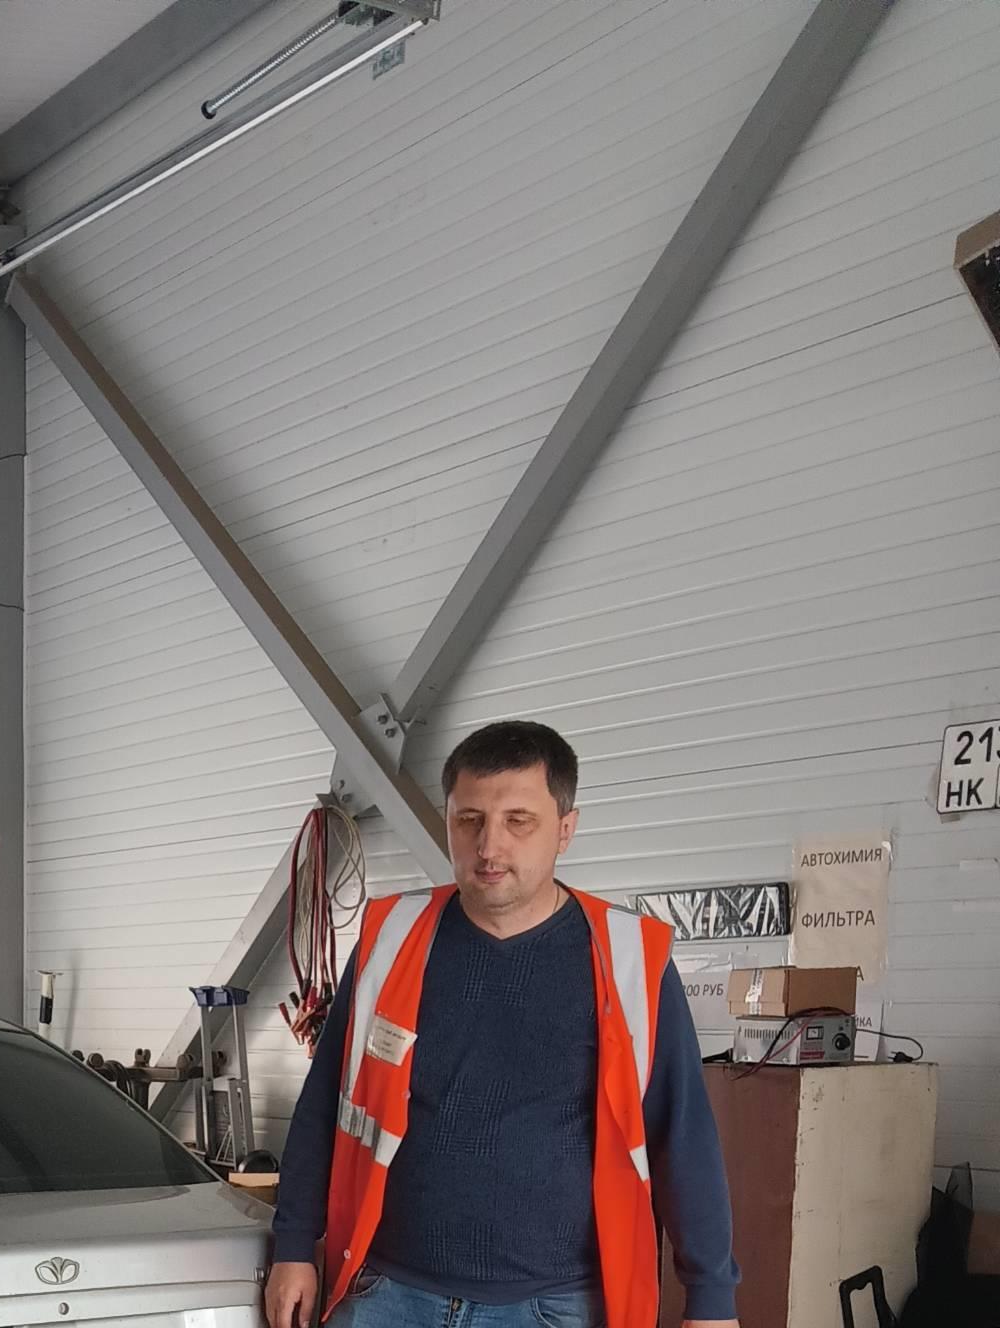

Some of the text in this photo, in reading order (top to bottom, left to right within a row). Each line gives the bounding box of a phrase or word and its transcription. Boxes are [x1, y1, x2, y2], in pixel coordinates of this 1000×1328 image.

[954, 727, 1000, 766] 21
[800, 848, 883, 868] АВТОХИМИЯ
[801, 909, 876, 929] ФИЛЬТРА
[702, 983, 724, 997] РУБ
